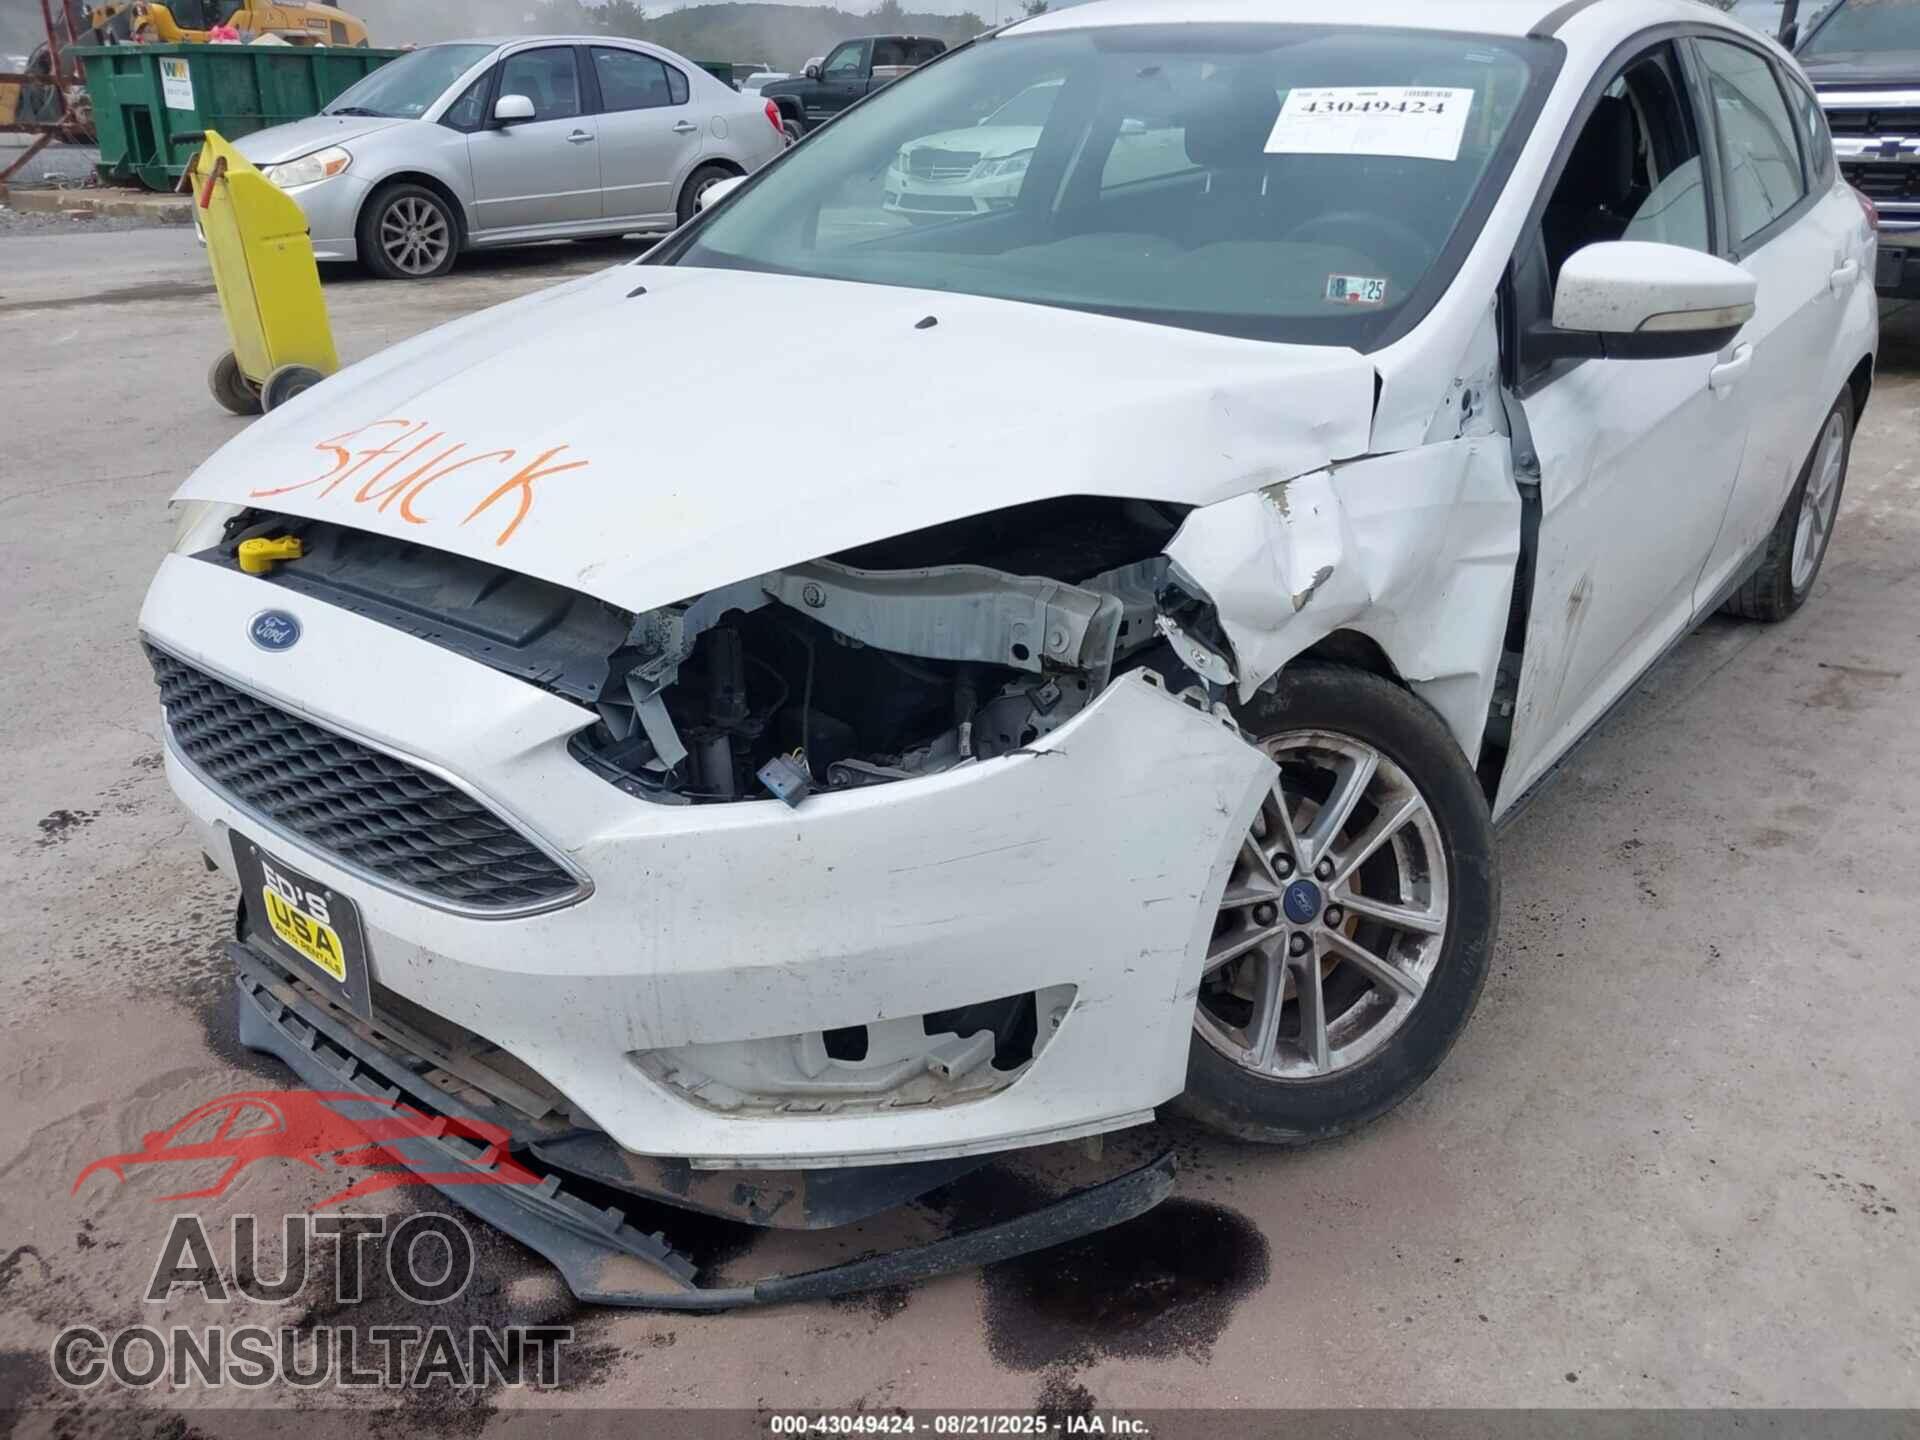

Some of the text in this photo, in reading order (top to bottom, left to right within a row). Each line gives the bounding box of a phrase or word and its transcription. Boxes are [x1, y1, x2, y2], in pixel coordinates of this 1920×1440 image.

[1301, 101, 1445, 115] 43049424
[1367, 281, 1383, 300] 25
[256, 616, 290, 644] Ford
[262, 860, 330, 924] ED'S
[269, 892, 337, 960] USA
